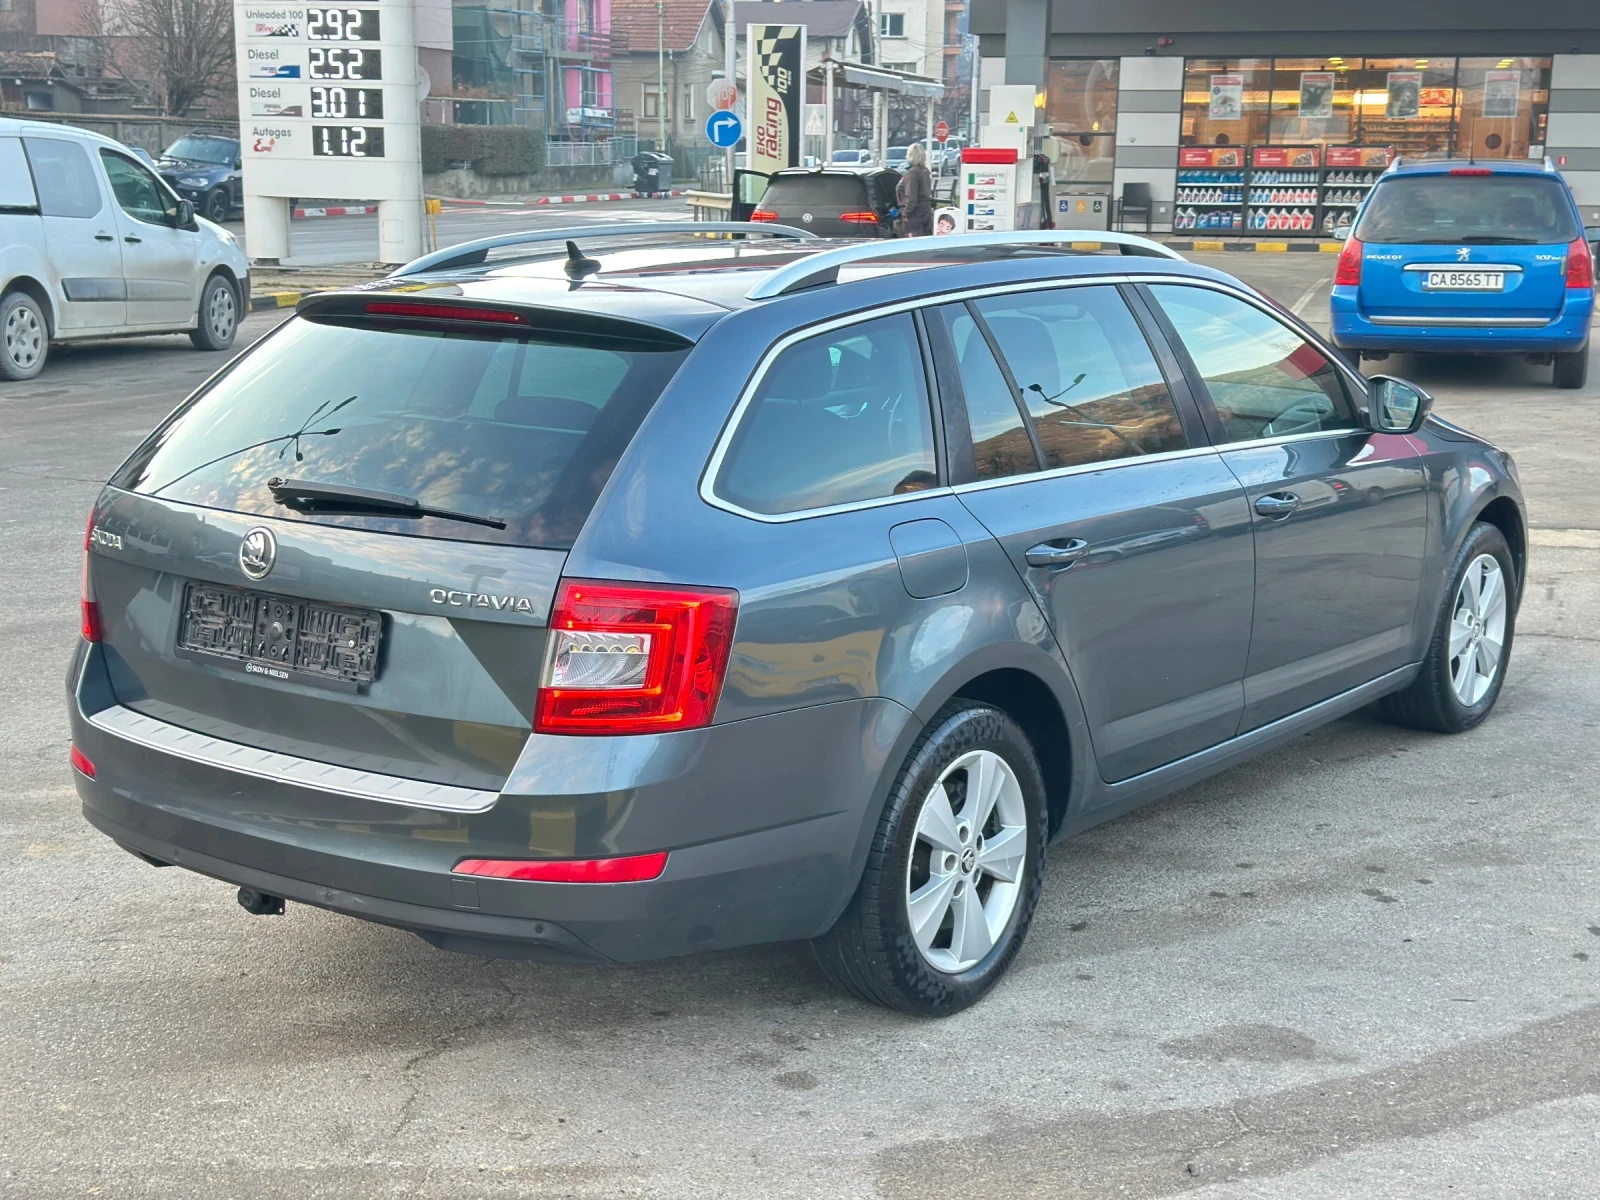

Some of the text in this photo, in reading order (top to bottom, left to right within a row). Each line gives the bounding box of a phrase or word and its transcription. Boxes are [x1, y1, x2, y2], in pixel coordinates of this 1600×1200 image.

[245, 9, 303, 19] Unleaded 100
[307, 9, 362, 40] 2.92
[247, 49, 279, 60] Diesel
[309, 48, 363, 79] 2.52
[249, 87, 281, 98] Diesel
[777, 67, 788, 94] 100
[312, 87, 366, 118] 3.01
[252, 127, 292, 139] Autogas
[322, 127, 366, 156] 1.12
[756, 125, 766, 156] EKO
[765, 97, 782, 160] racing
[429, 588, 535, 614] OCTAVIA
[269, 668, 289, 680] NIELSEN
